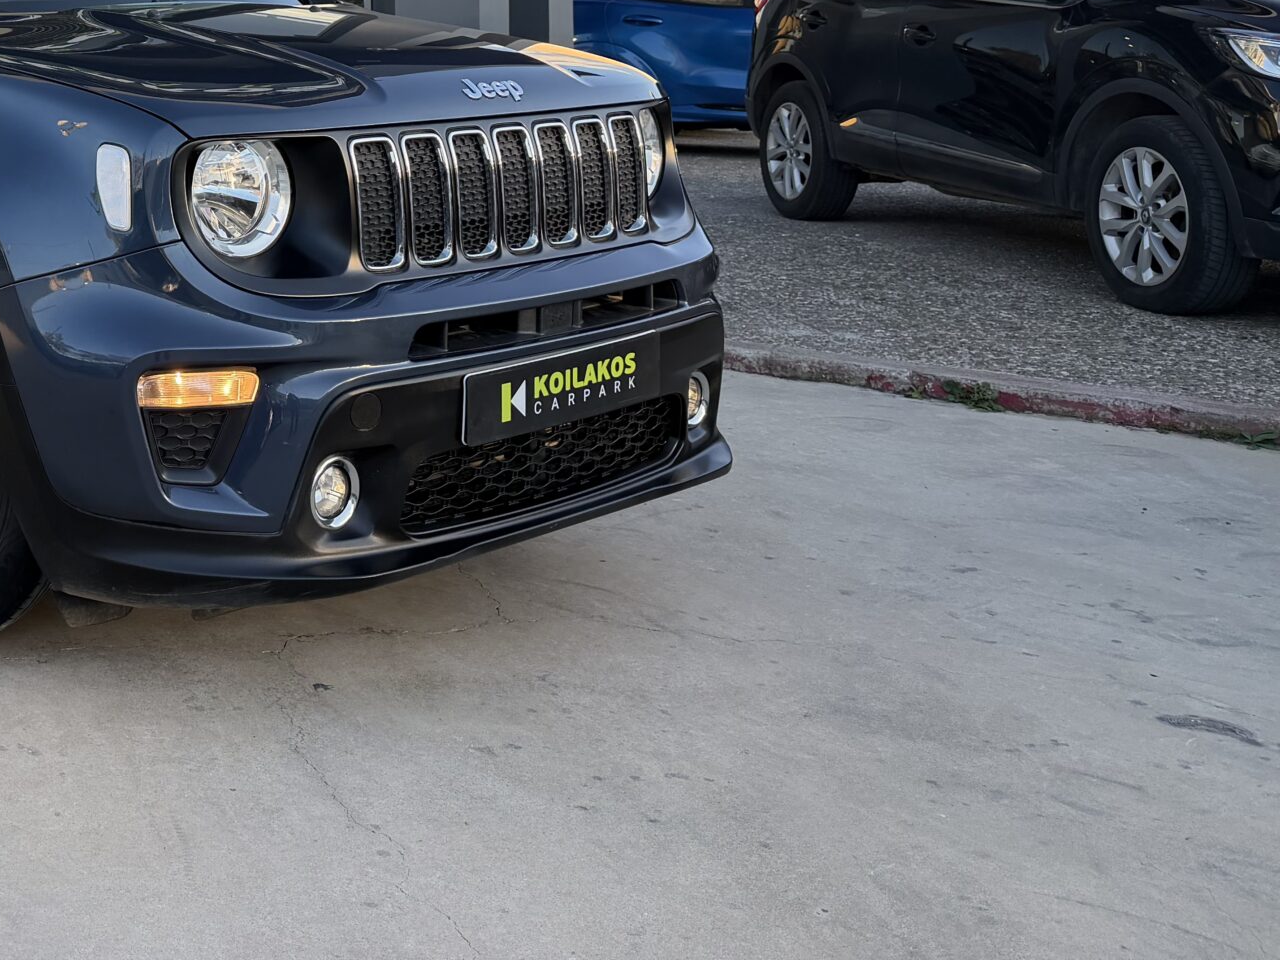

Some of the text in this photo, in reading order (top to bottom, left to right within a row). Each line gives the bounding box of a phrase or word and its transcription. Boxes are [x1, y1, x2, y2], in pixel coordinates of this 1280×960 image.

[460, 78, 524, 101] Jeep
[533, 352, 637, 399] KOILAKOS
[533, 375, 636, 415] CARPARK
